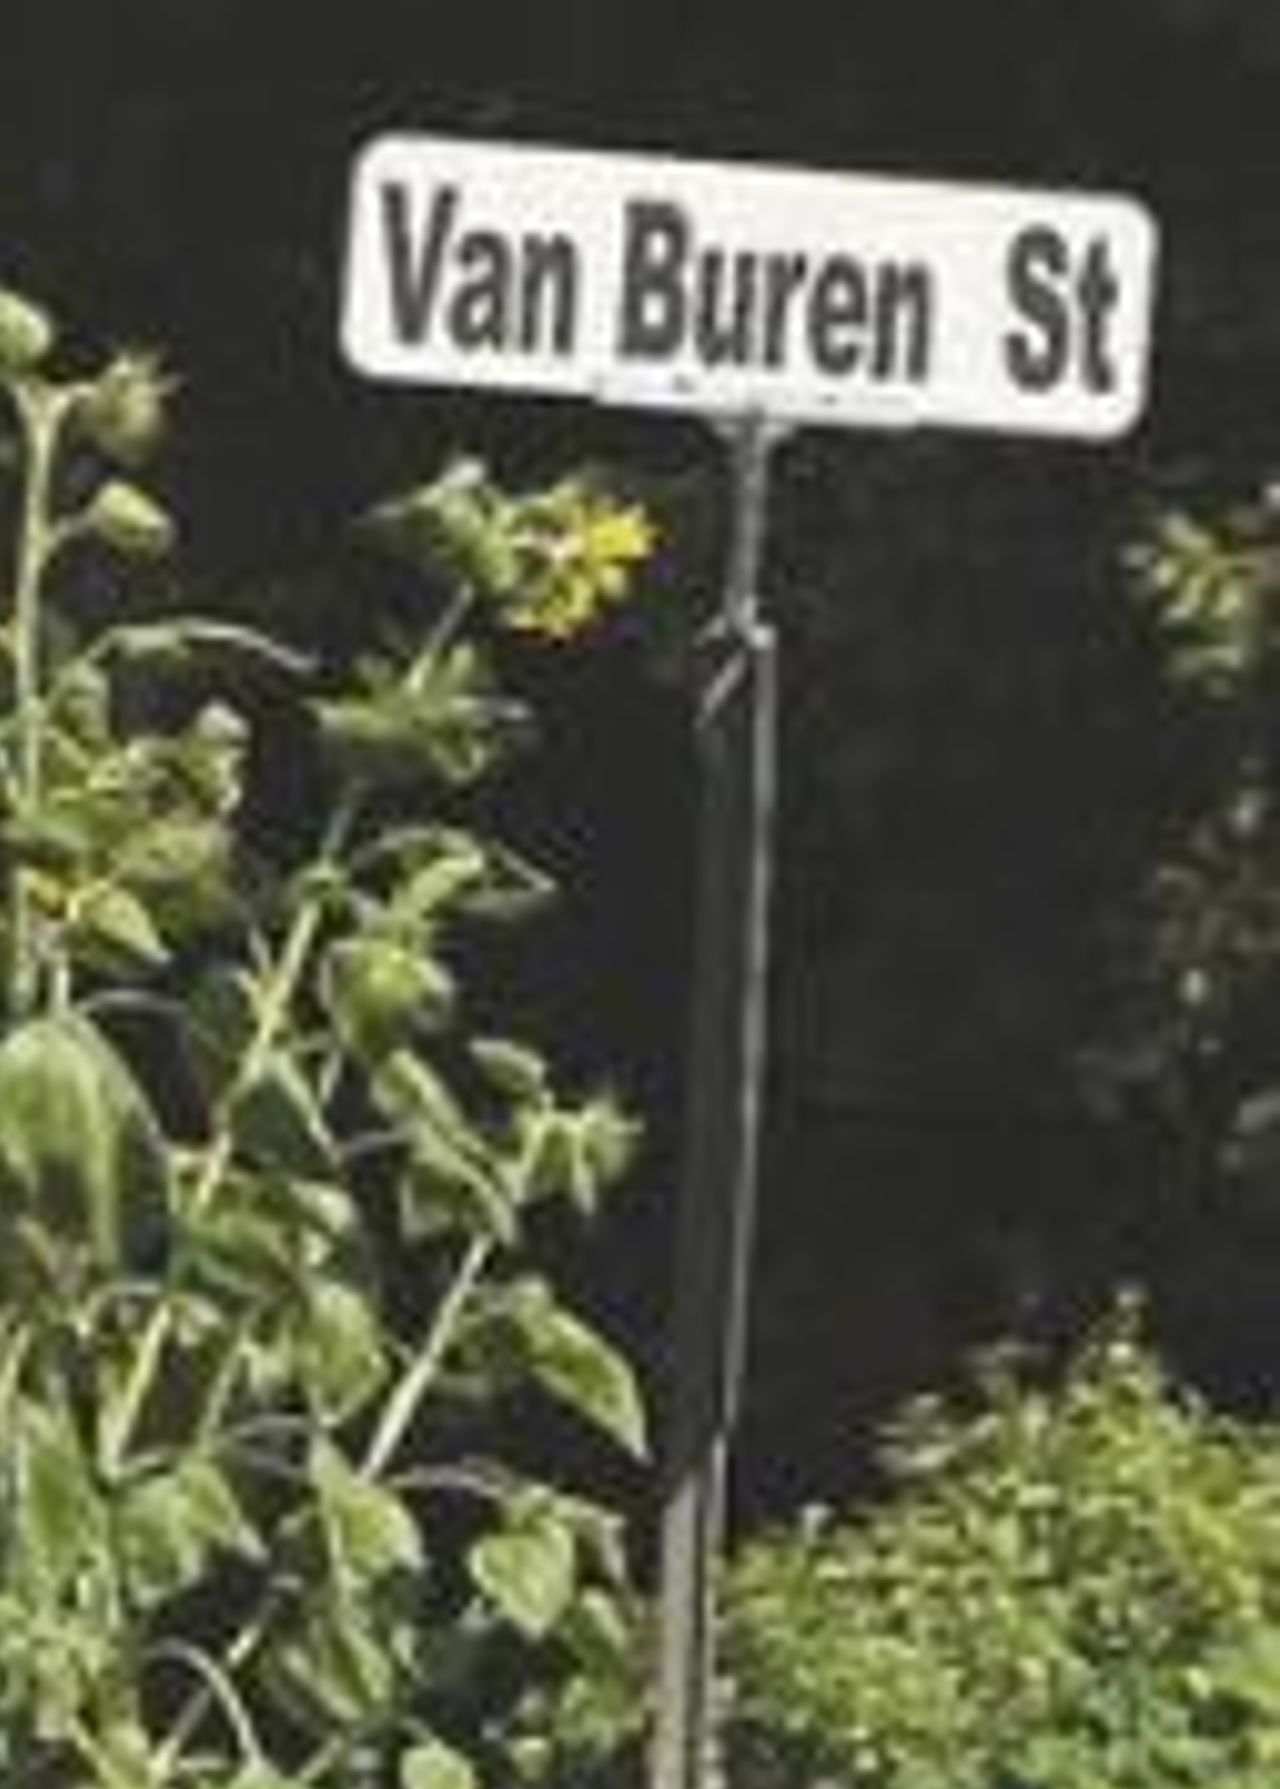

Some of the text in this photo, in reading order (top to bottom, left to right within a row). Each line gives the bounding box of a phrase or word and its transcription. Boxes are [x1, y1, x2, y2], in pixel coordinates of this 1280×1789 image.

[380, 182, 1119, 395] Van Buren St
